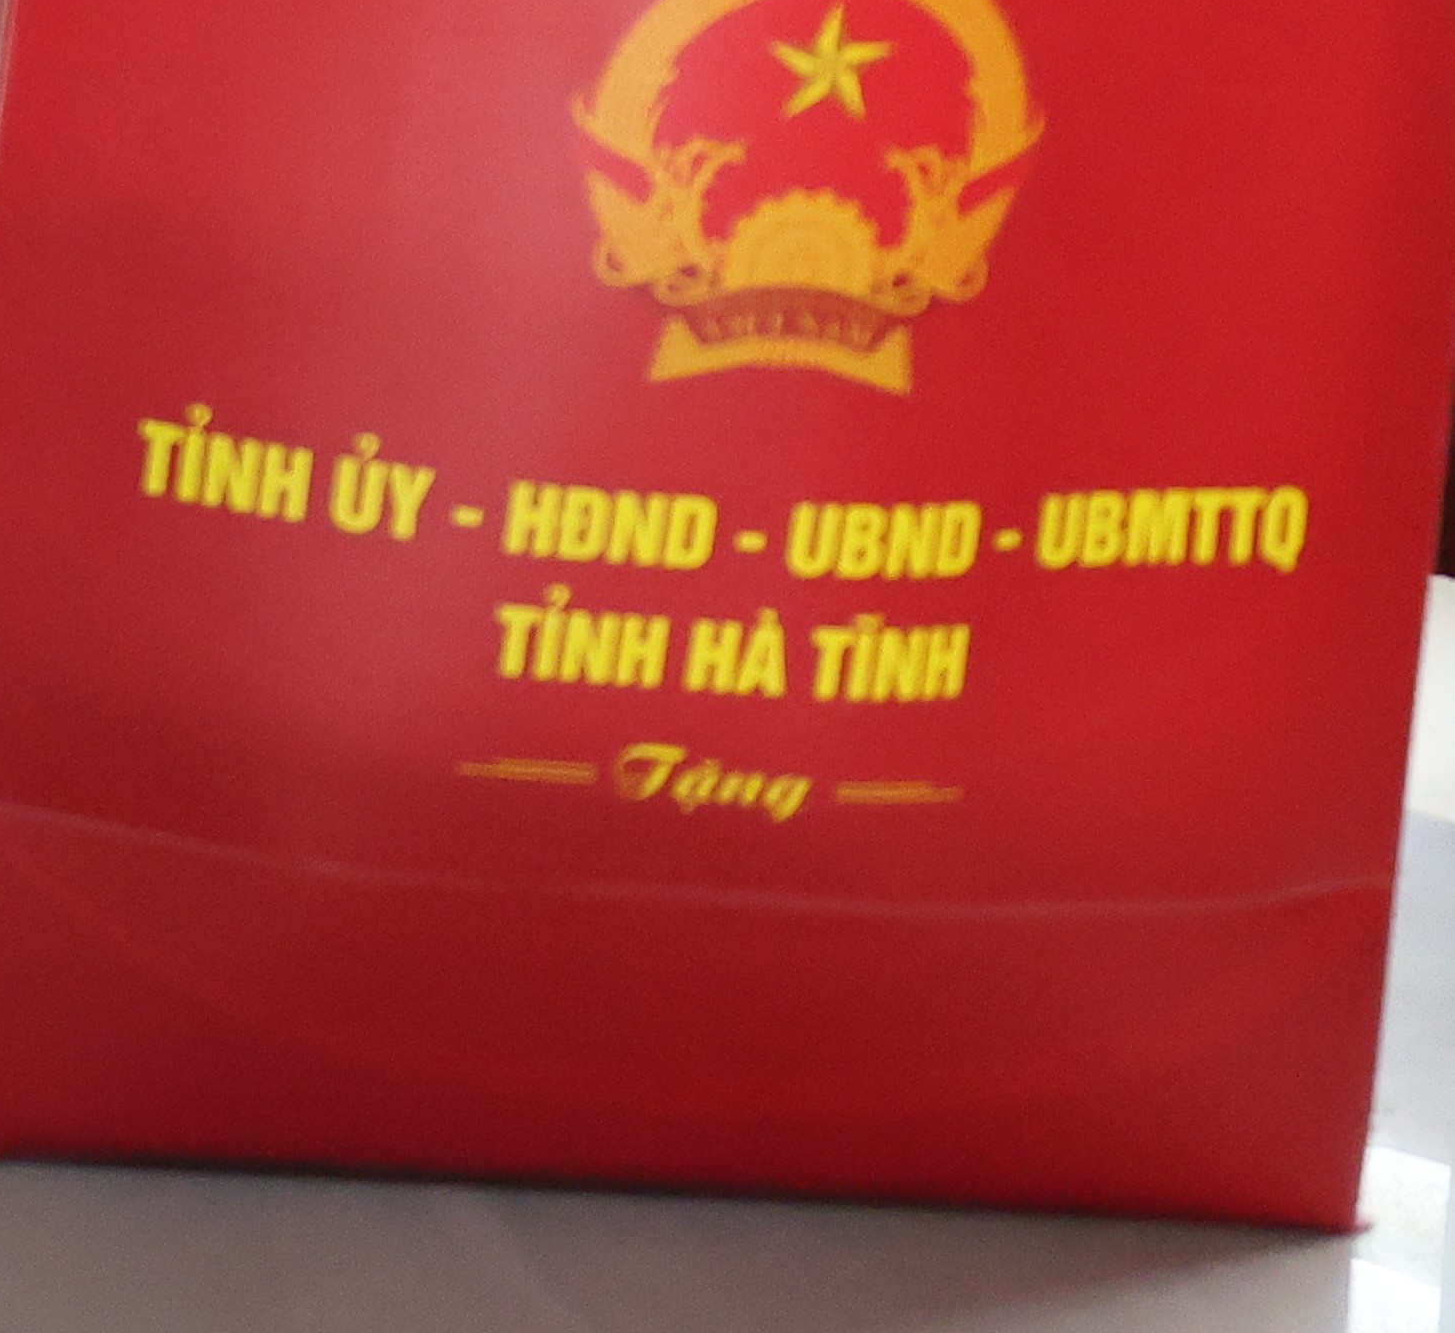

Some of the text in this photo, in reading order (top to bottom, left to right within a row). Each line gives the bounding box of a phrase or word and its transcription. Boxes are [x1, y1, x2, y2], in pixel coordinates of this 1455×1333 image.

[138, 401, 314, 524] TỈNH
[328, 430, 436, 542] ỦY
[501, 478, 720, 571] HĐND
[786, 499, 983, 581] UBND
[1037, 484, 1309, 573] UBMTTQ
[494, 583, 972, 703] TỈNH HÀ TĨNH
[613, 741, 814, 823] Tặng
